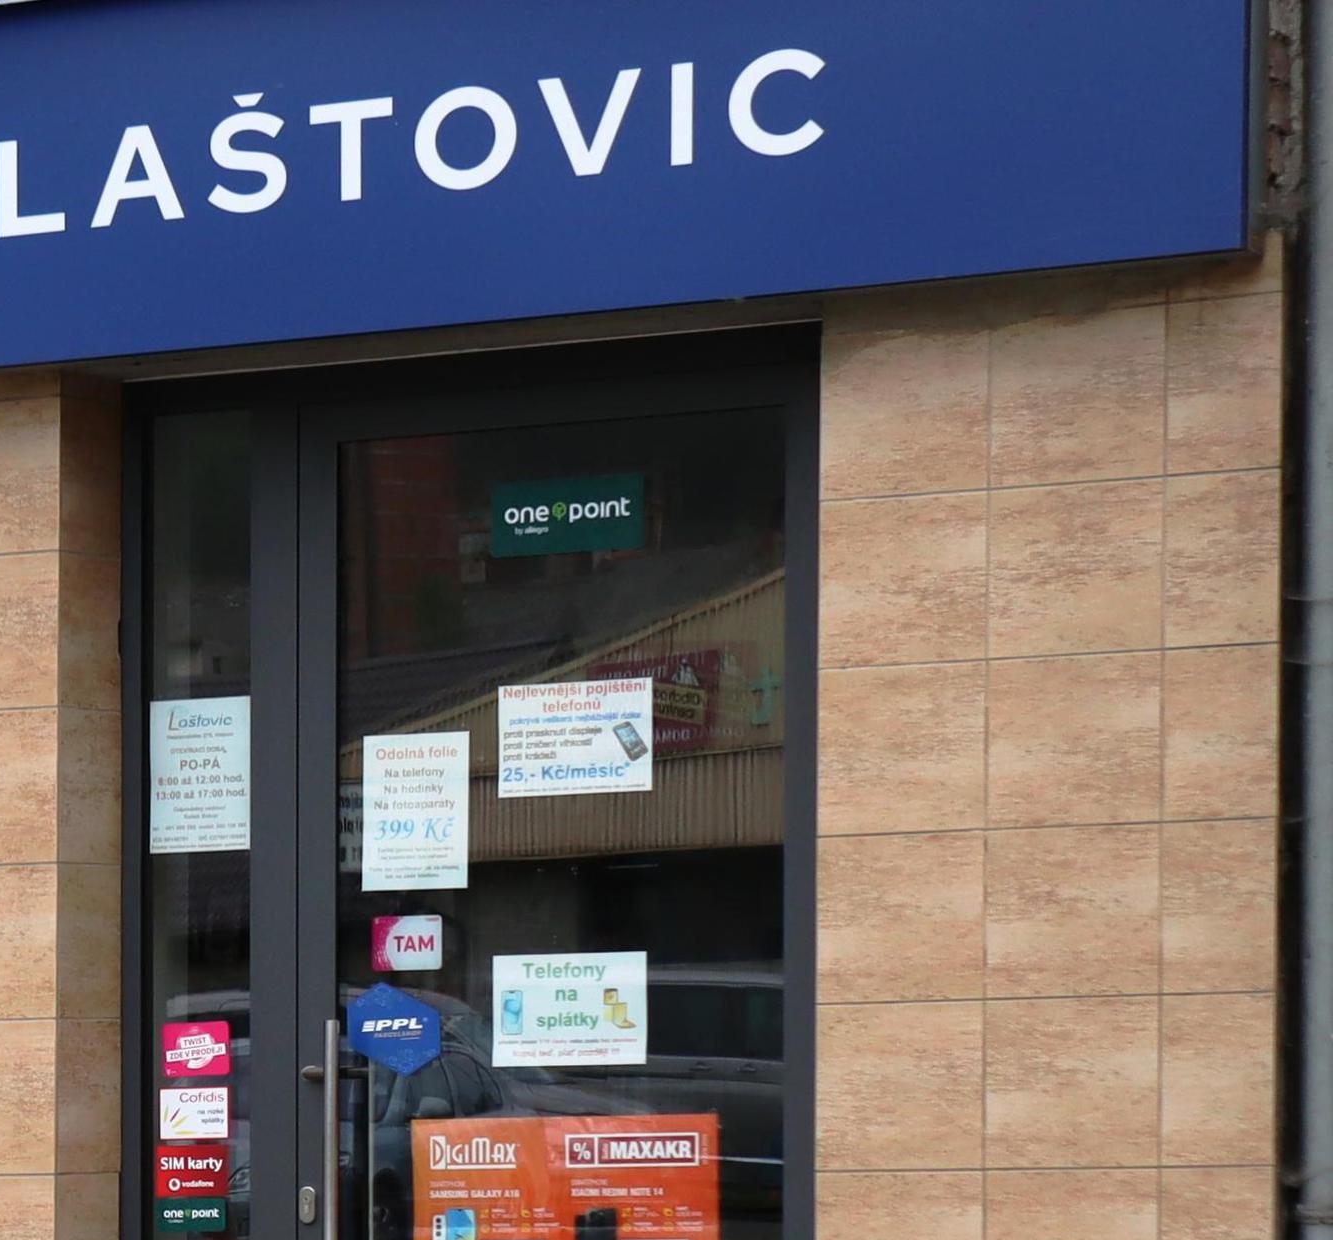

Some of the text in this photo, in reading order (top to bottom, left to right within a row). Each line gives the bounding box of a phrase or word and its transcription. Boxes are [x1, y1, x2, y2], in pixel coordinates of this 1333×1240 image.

[502, 681, 646, 701] Nejlevnější pojištění
[542, 698, 602, 713] telefonů
[376, 746, 458, 761] Odolná folie
[179, 756, 220, 771] PO-PÁ
[384, 767, 445, 778] Na telefony
[383, 783, 444, 795] Na hodinky
[374, 801, 389, 810] Na
[393, 935, 435, 953] TAM
[522, 962, 606, 982] Telefony
[555, 987, 578, 1001] na
[376, 1017, 424, 1032] PPL
[536, 1012, 599, 1030] splátky
[183, 1037, 207, 1047] TWIST
[179, 1091, 225, 1104] Cofidis
[609, 1140, 692, 1159] MAXAKR
[160, 1156, 223, 1172] SIM karty
[182, 1179, 214, 1188] vodafone
